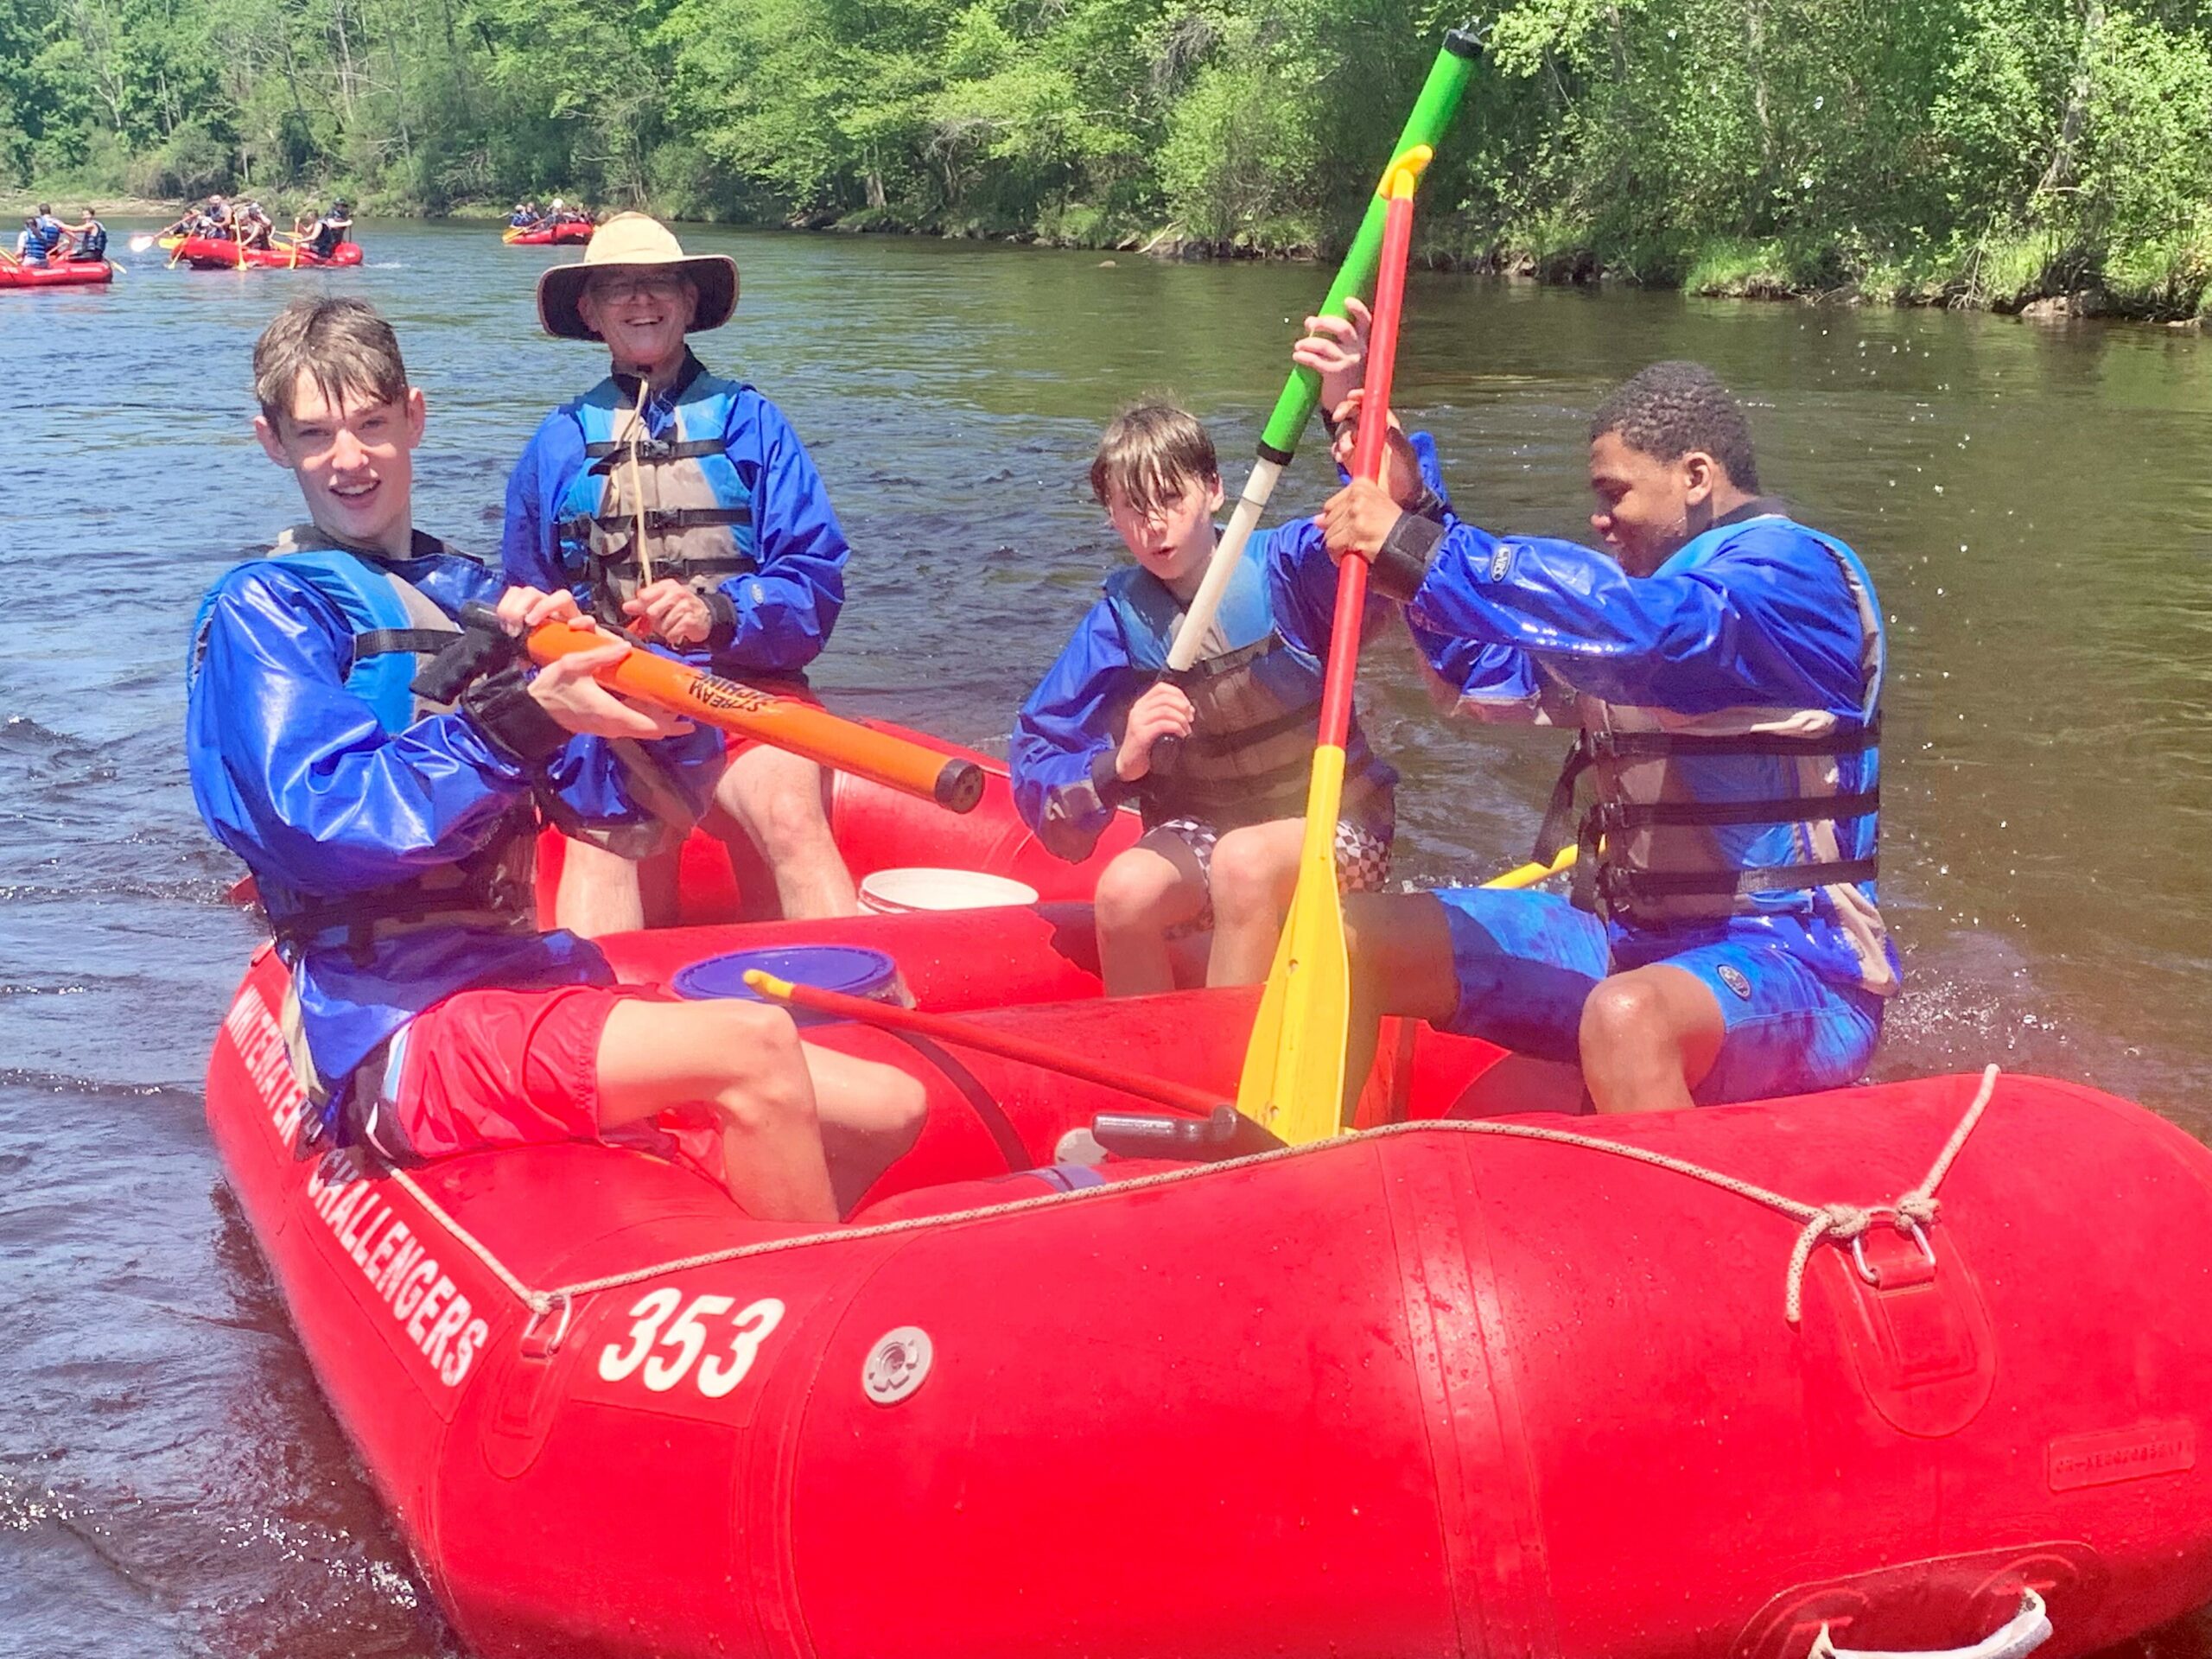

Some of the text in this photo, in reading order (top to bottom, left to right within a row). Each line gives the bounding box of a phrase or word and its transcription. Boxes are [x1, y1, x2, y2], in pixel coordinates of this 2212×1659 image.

[689, 680, 767, 712] STREAM
[694, 674, 777, 704] CHINE
[227, 983, 489, 1387] WHITEWATER CHALLENGERS
[598, 1287, 785, 1399] 353
